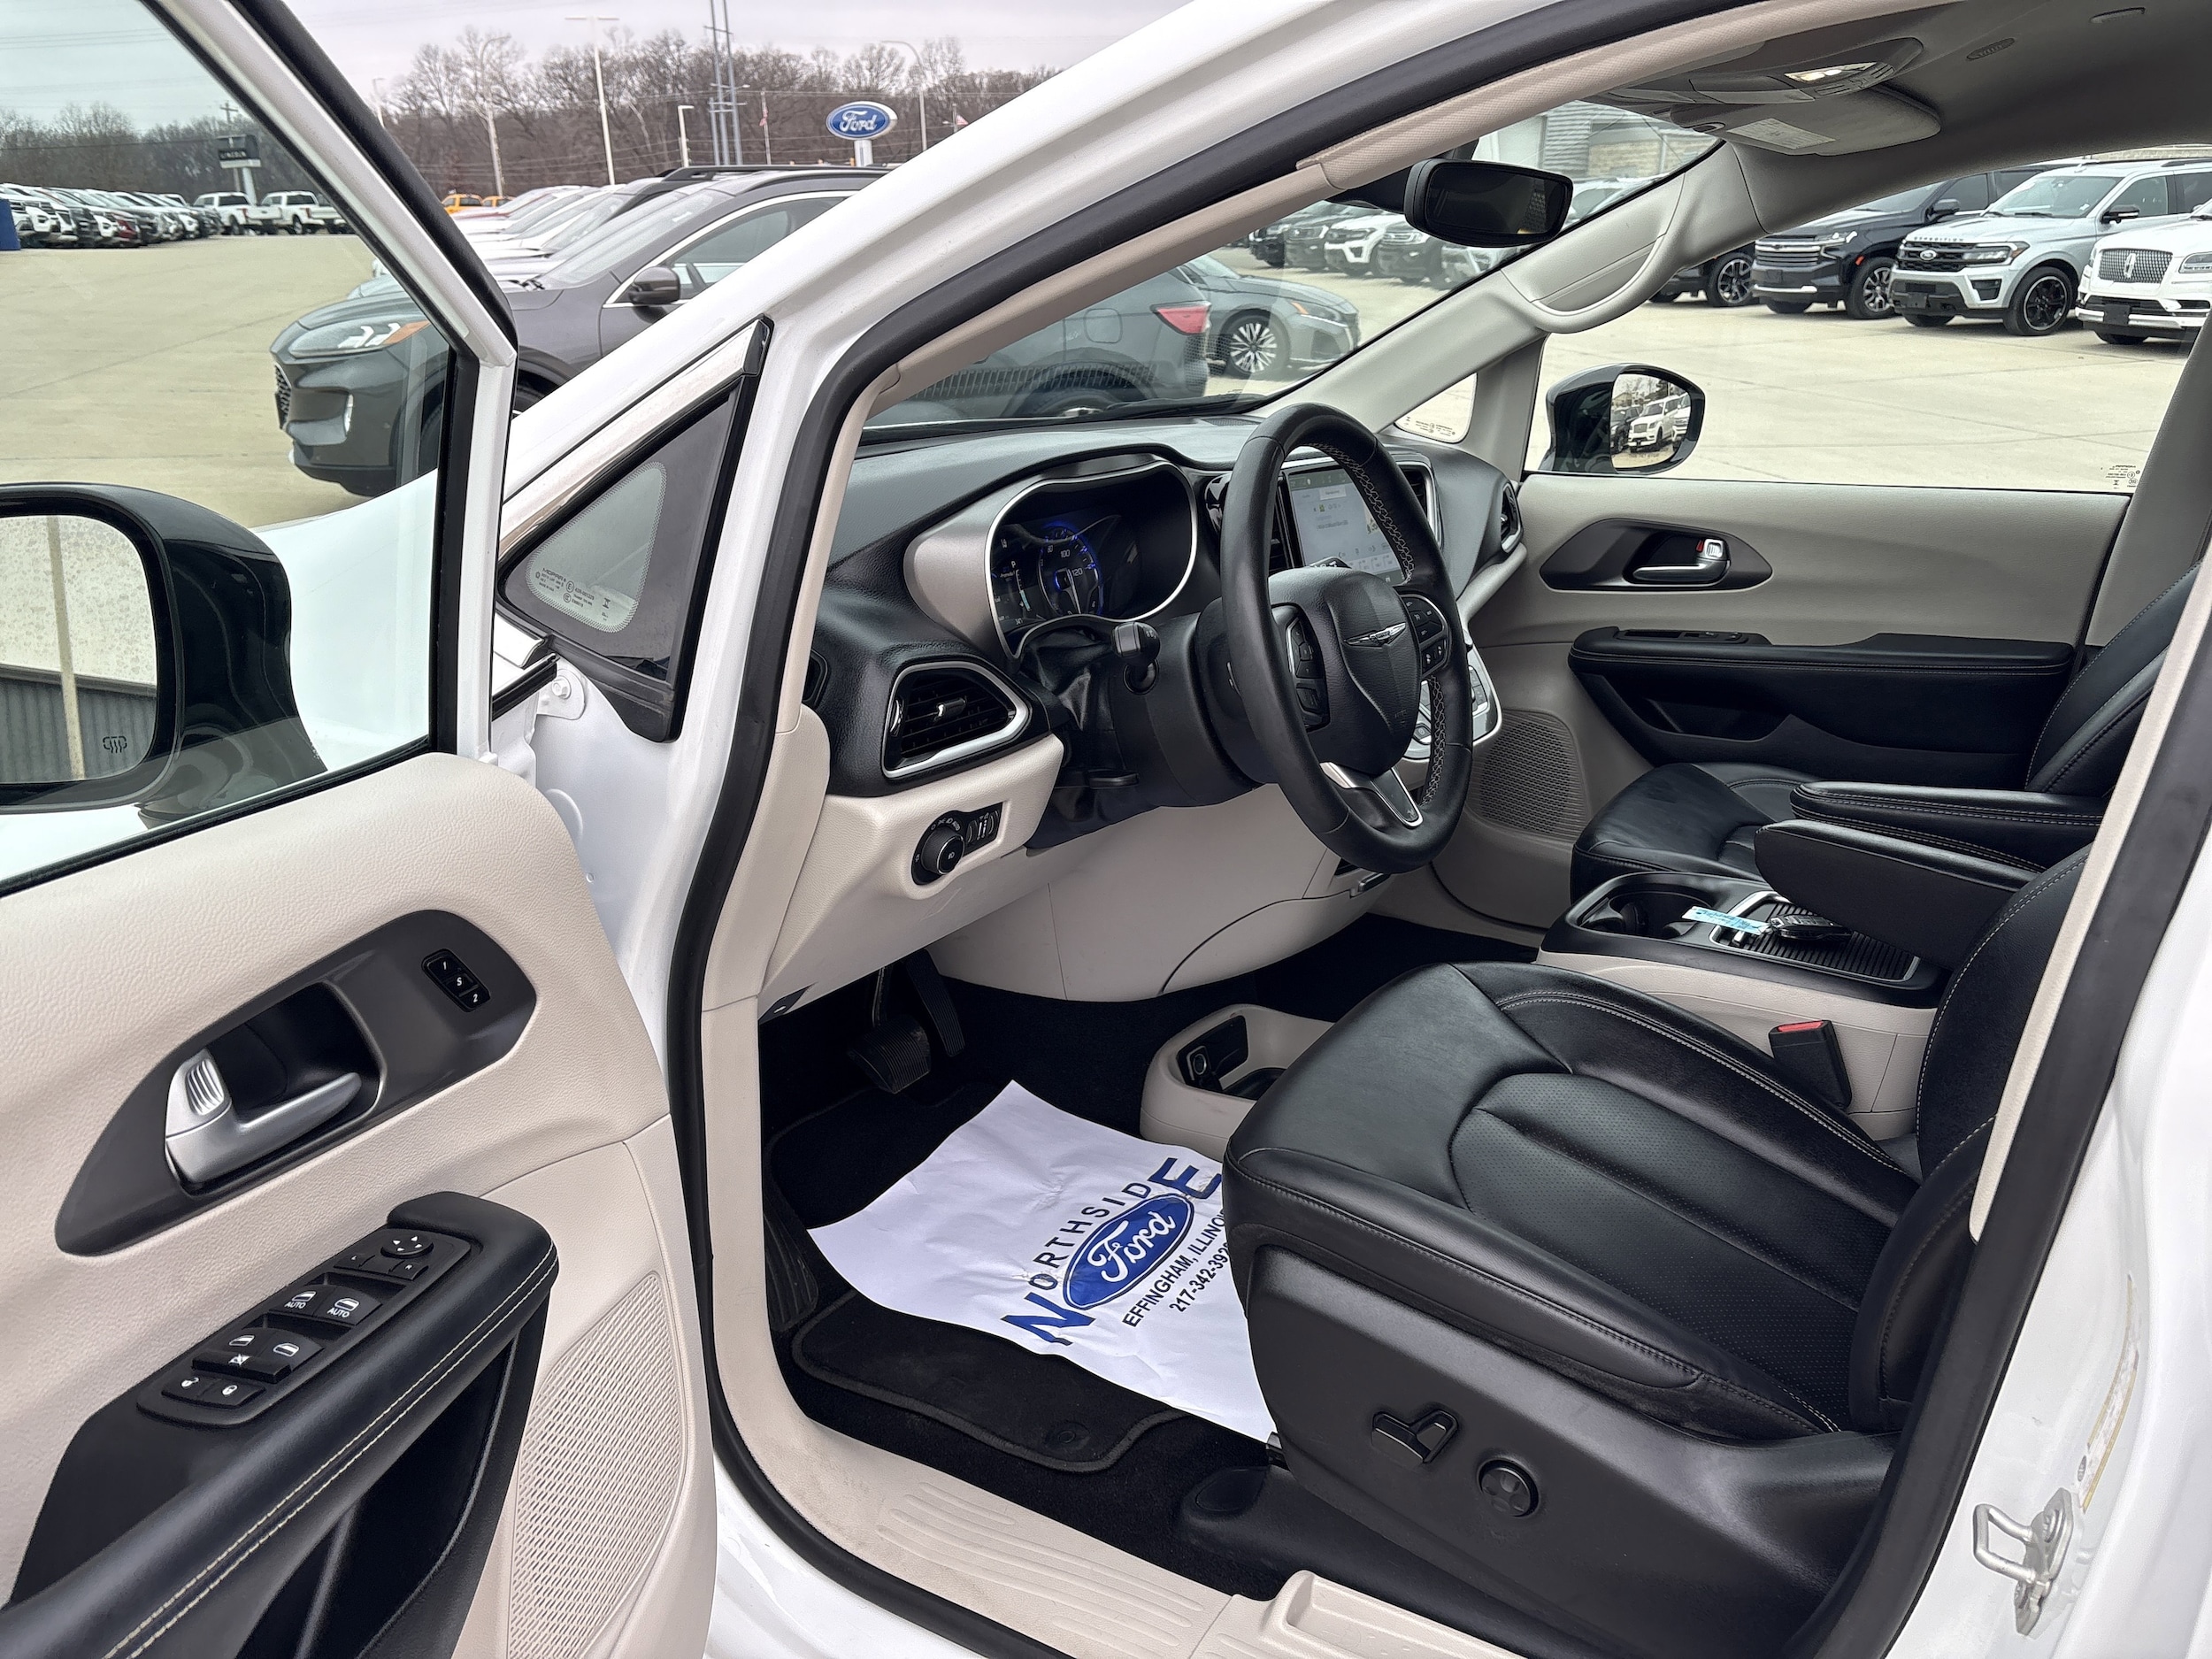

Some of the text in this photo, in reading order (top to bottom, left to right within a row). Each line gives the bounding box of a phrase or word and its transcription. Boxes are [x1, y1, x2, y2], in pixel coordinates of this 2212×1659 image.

[839, 110, 878, 132] Ford
[1060, 549, 1071, 558] 100
[1071, 568, 1083, 577] 120
[442, 961, 447, 971] 1
[457, 976, 463, 987] S
[472, 993, 479, 1003] 2
[1001, 1157, 1223, 1346] NORTHSIDE
[1087, 1210, 1177, 1283] Ford
[1122, 1208, 1225, 1328] EFFINGHAM, ILLINO
[327, 1308, 350, 1317] AUTO
